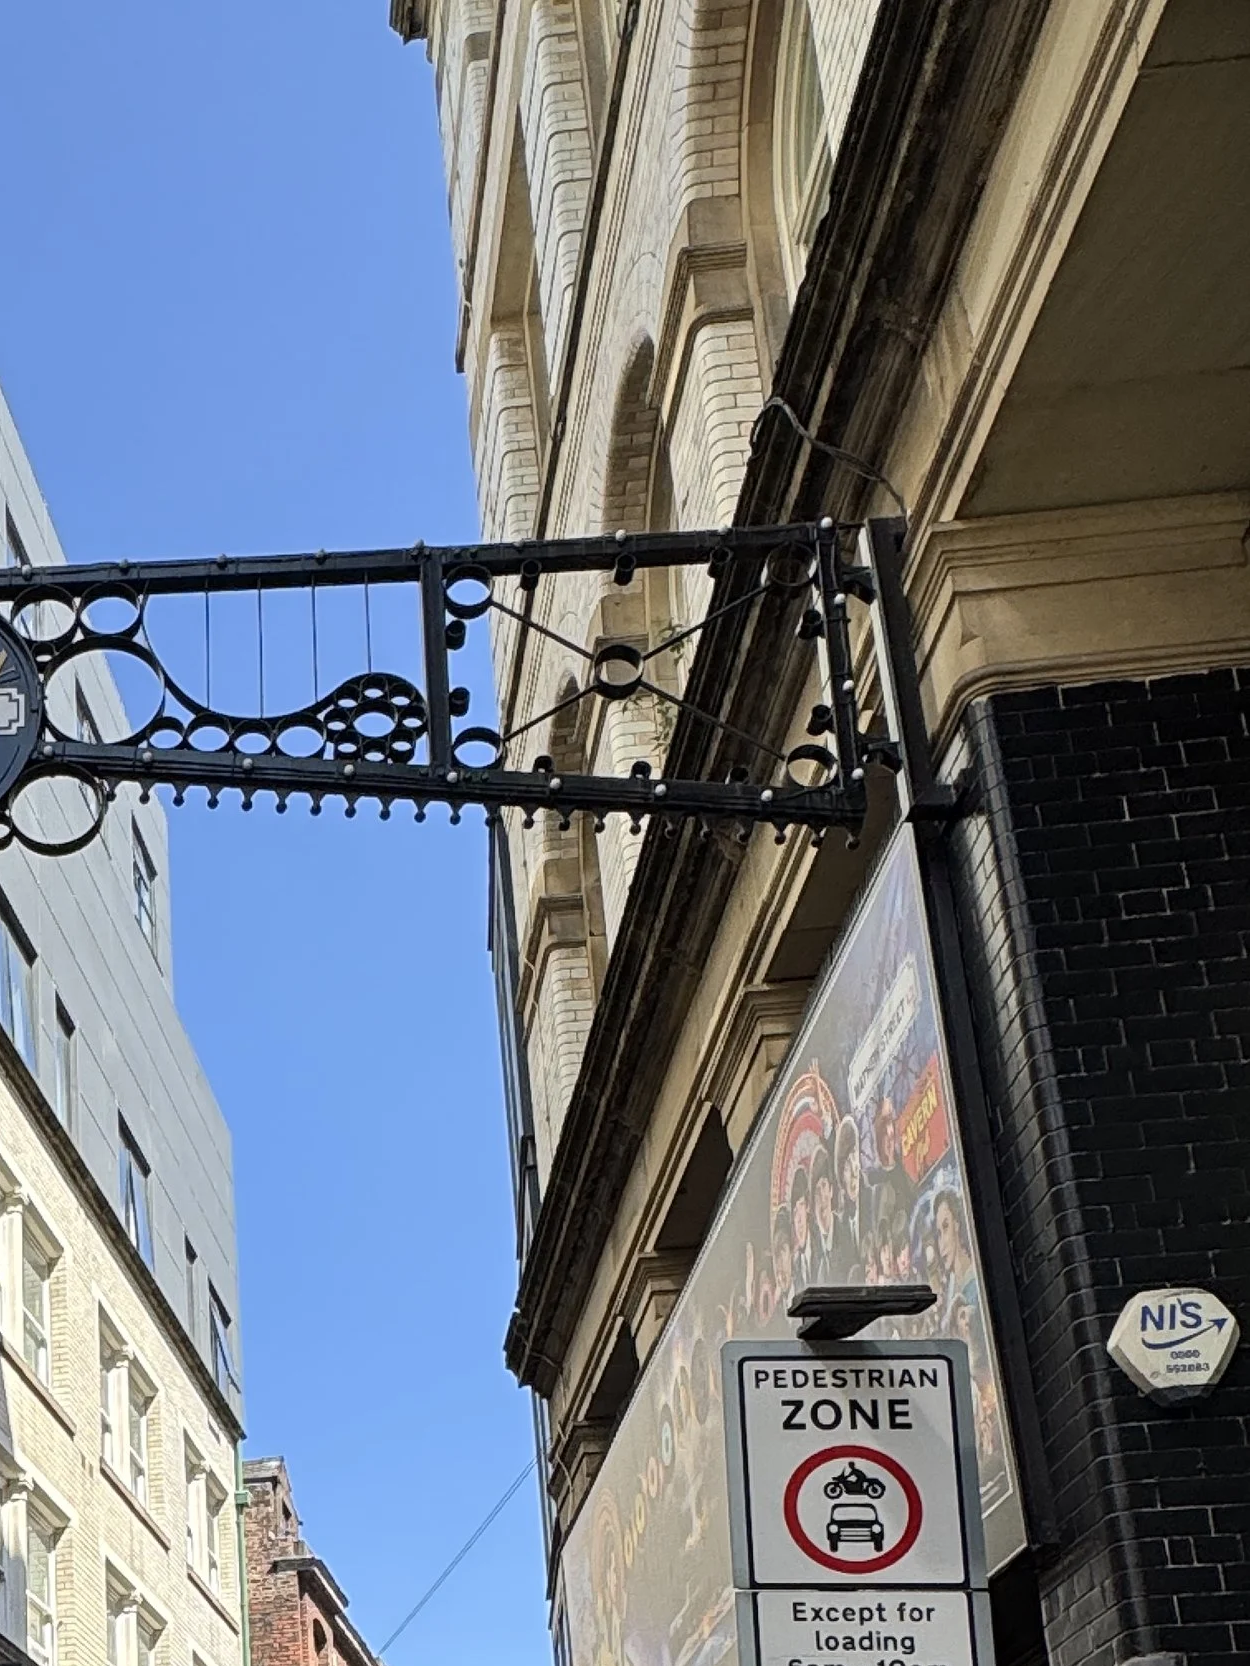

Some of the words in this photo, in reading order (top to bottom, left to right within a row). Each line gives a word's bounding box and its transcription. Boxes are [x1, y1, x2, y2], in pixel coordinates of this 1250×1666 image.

[1141, 1301, 1202, 1332] NIS
[754, 1367, 939, 1389] PEDESTRIAN
[780, 1398, 913, 1431] ZONE
[792, 1602, 888, 1626] Except
[897, 1602, 936, 1622] for
[815, 1631, 916, 1655] loading
